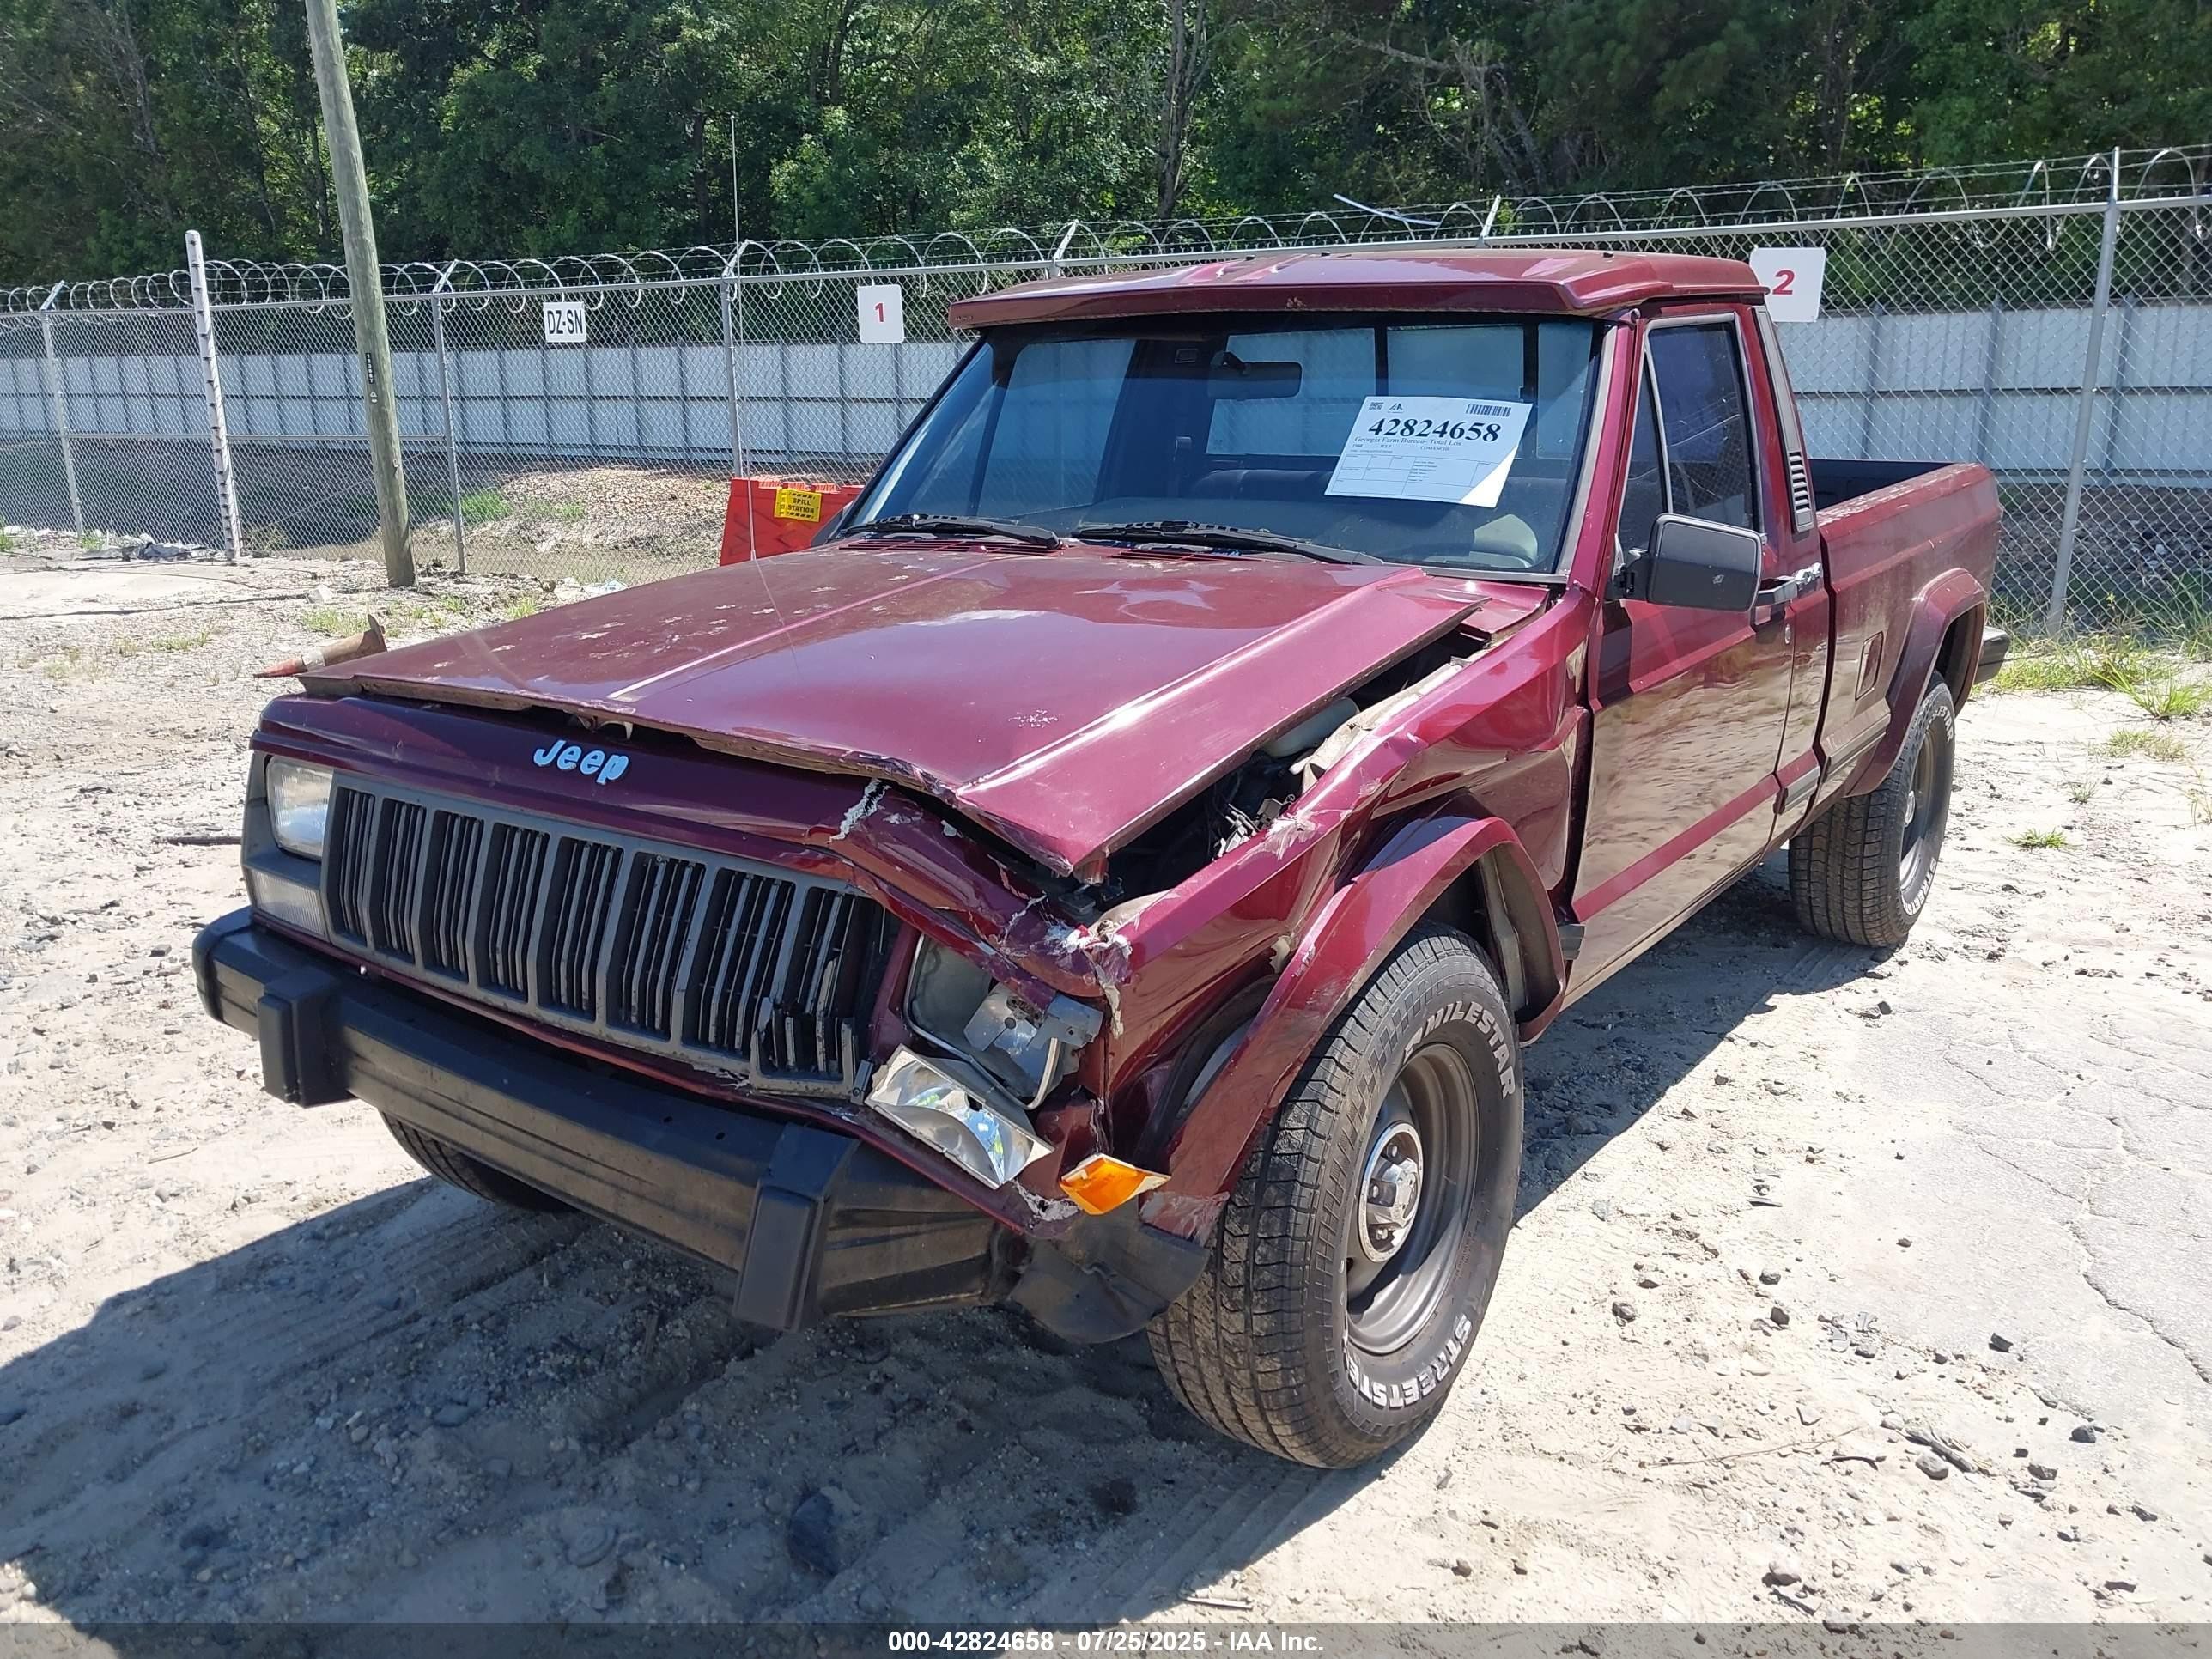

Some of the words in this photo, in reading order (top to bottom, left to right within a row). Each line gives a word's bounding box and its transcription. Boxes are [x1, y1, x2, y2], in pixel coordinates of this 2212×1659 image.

[1772, 270, 1796, 295] 2
[547, 309, 584, 334] DZ-SN
[875, 302, 884, 323] 1
[1368, 418, 1501, 441] 42824658
[787, 504, 815, 514] STATION
[793, 497, 811, 506] SPILL
[533, 739, 629, 785] Jeep
[1423, 1000, 1516, 1100] MILESTAR
